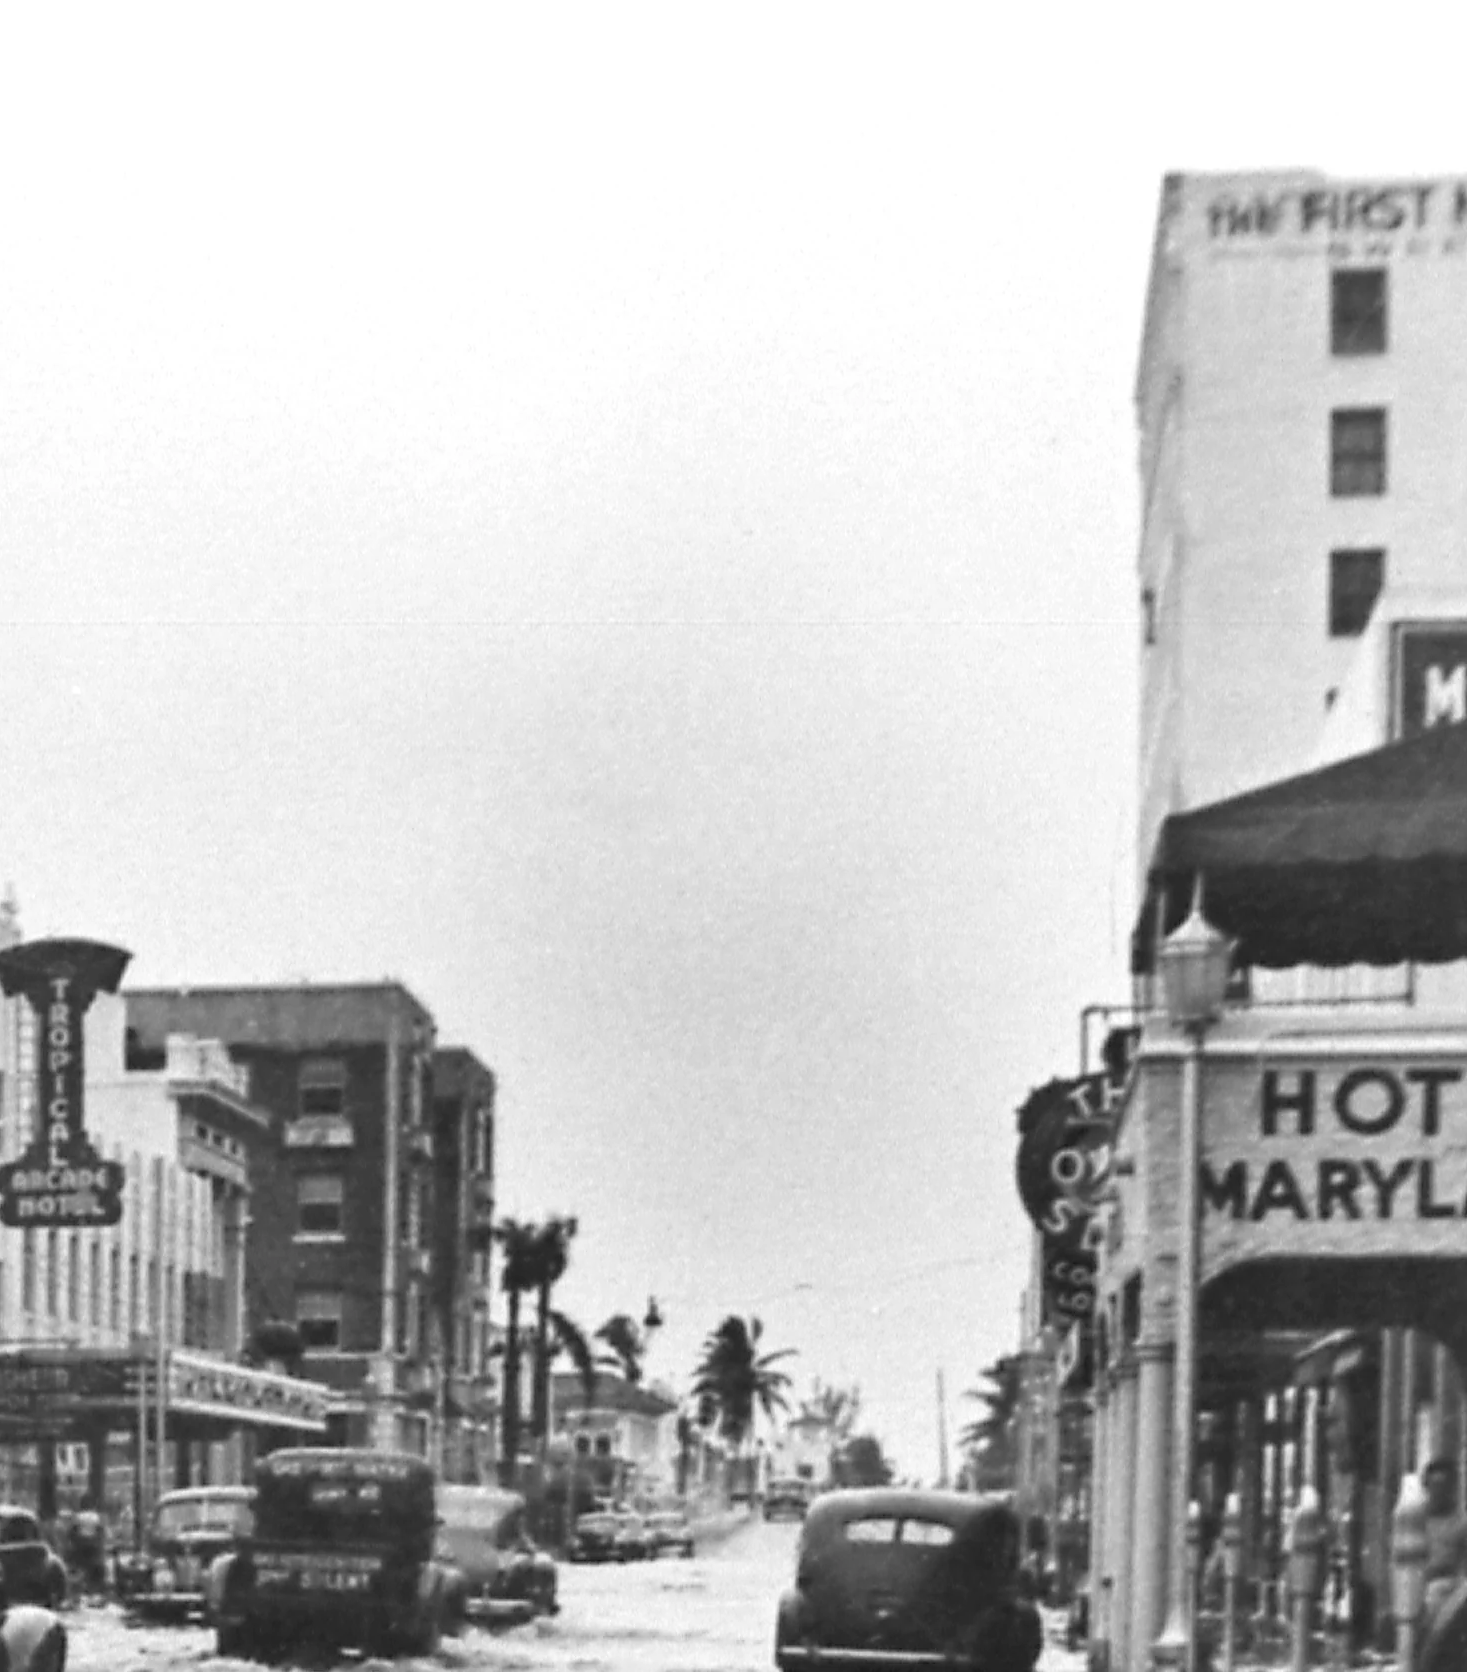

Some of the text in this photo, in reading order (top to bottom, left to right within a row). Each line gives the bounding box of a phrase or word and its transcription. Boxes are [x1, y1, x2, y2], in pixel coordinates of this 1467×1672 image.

[48, 977, 71, 1168] TROPICAL
[1262, 1068, 1463, 1136] HOT
[11, 1168, 108, 1190] ARCADE
[1199, 1159, 1467, 1221] MARYL
